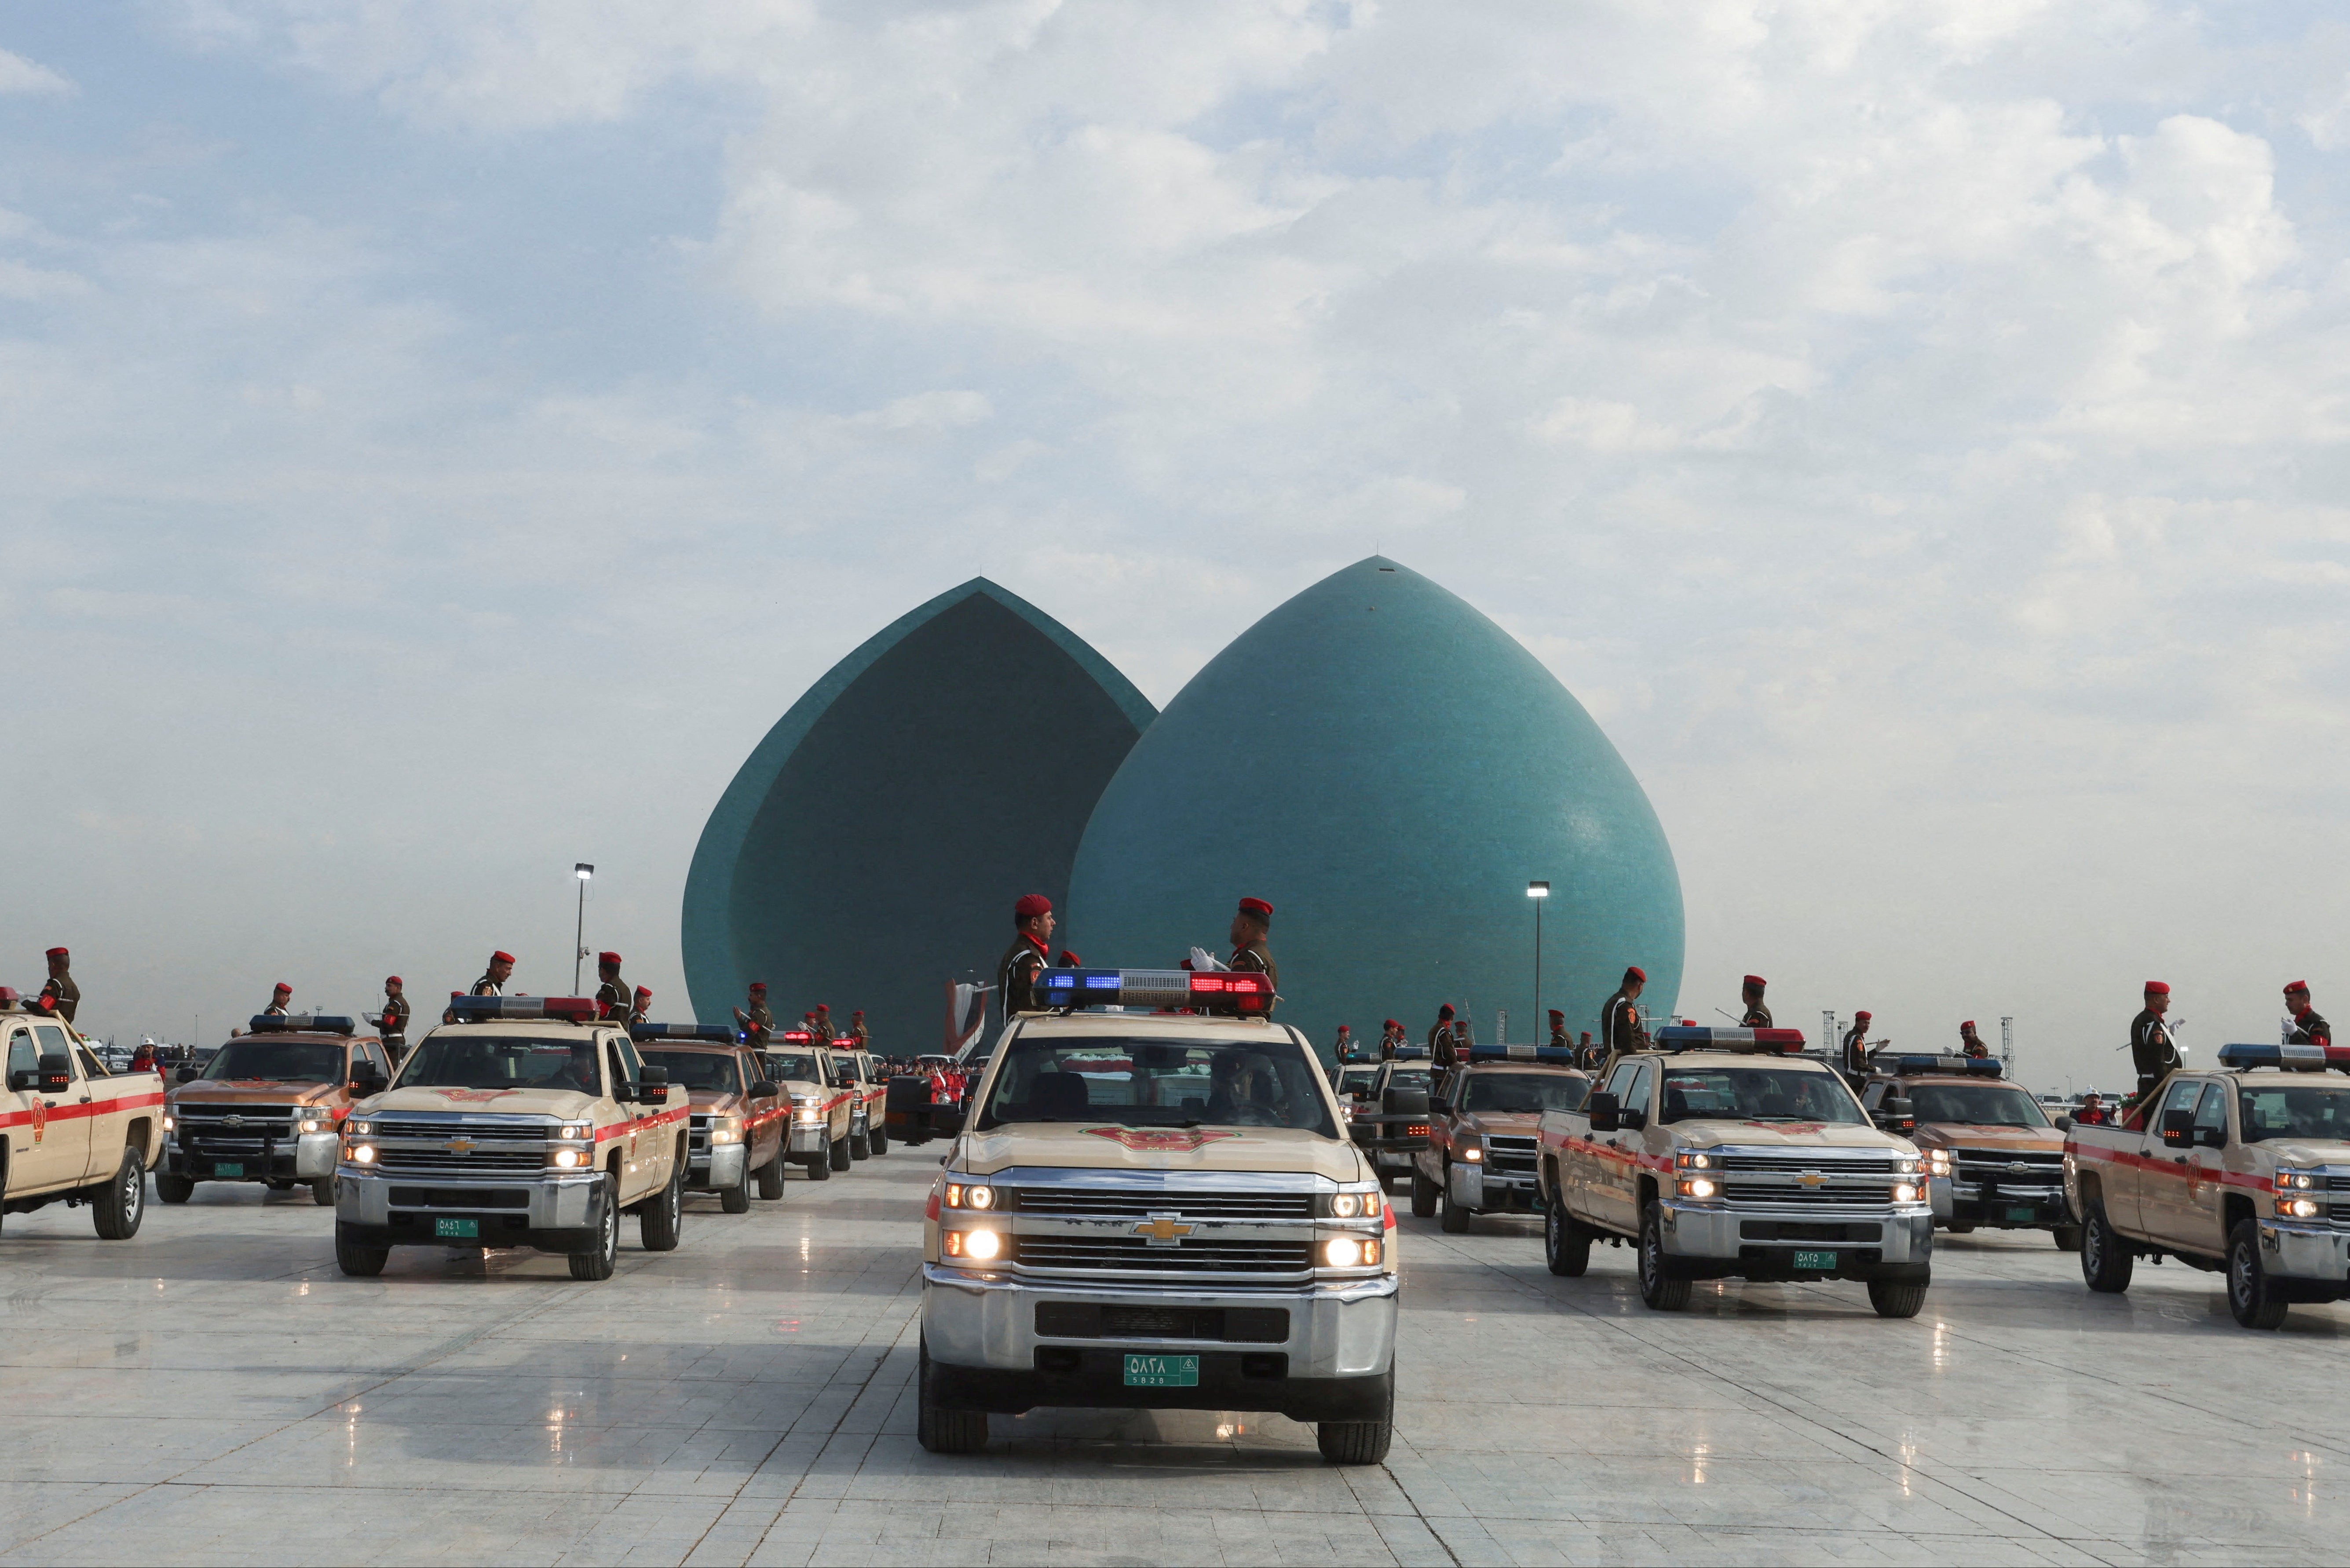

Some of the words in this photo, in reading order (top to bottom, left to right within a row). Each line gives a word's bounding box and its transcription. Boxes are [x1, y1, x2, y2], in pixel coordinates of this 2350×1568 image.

[440, 1220, 459, 1229] ٥٨٤٦
[1798, 1253, 1818, 1262] ٥٨٢٥
[1131, 1357, 1166, 1374] ٥٨٢٨
